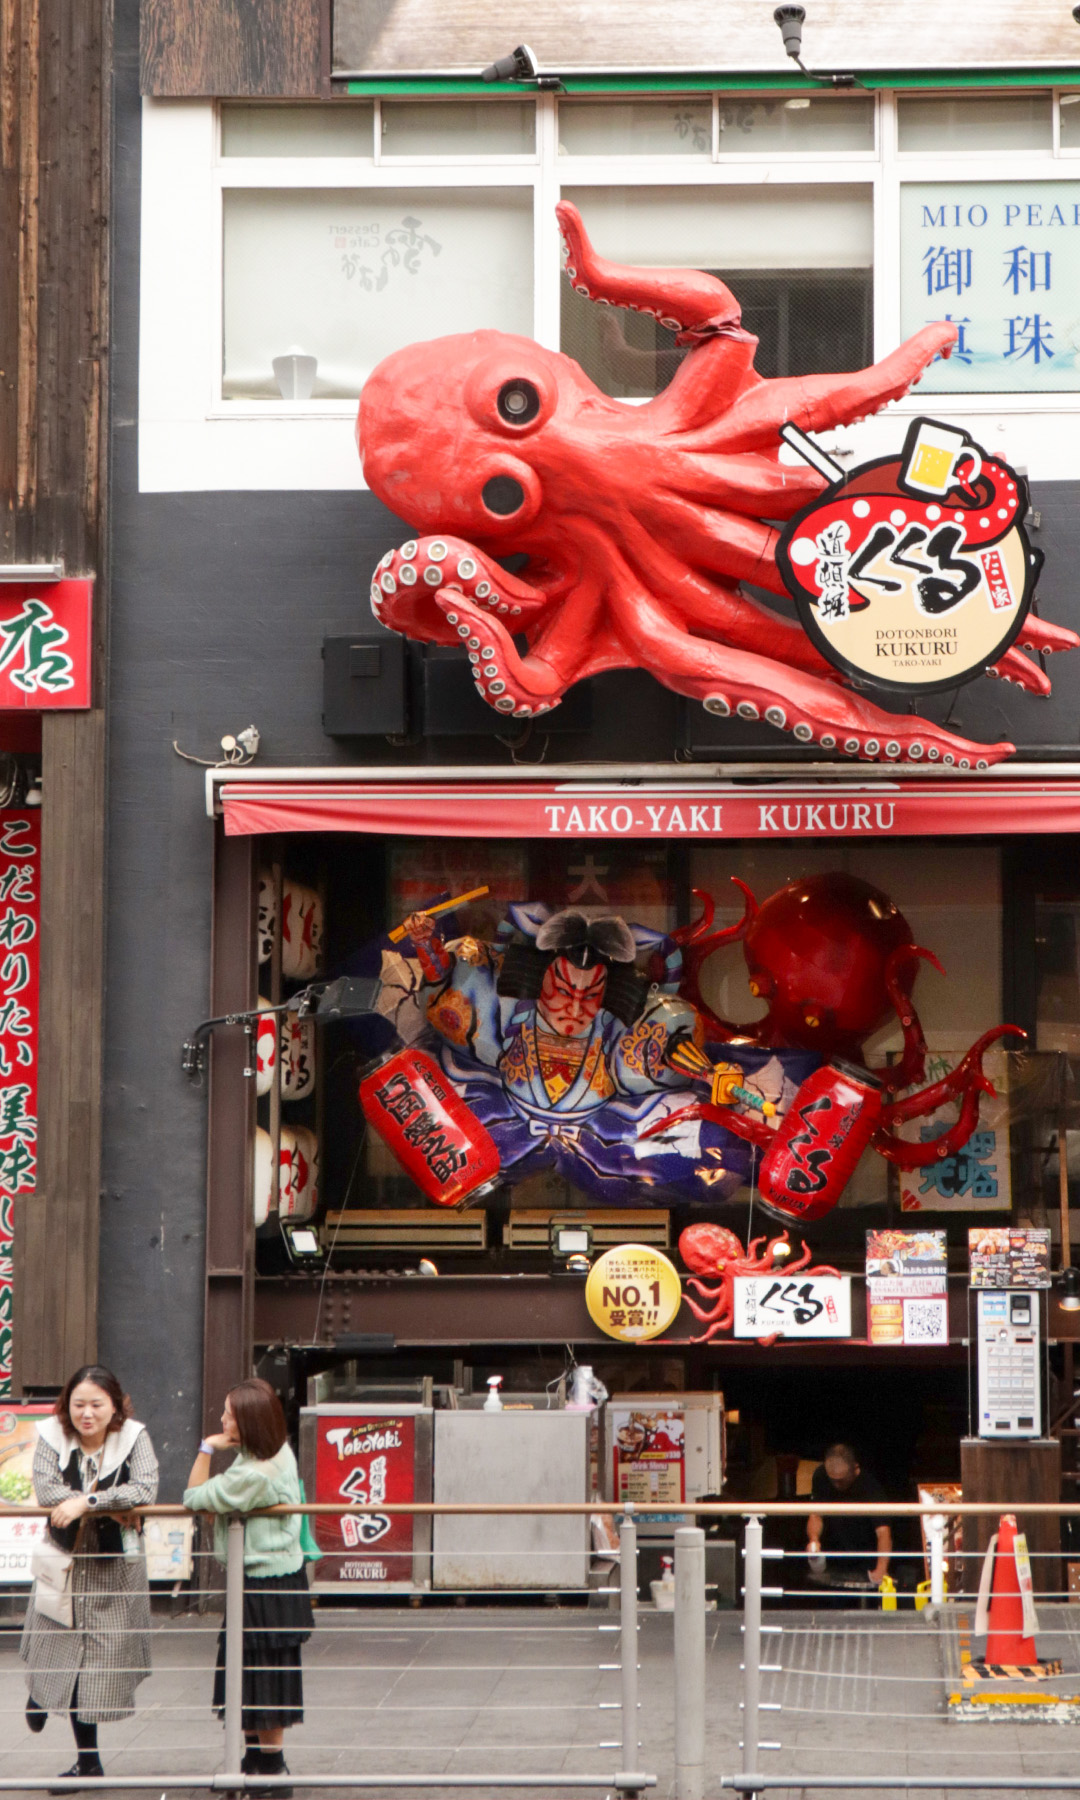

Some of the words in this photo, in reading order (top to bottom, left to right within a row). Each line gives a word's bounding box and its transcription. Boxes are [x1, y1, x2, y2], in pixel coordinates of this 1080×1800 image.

[921, 204, 988, 228] MIO
[819, 525, 849, 619] 道頓堀
[848, 526, 982, 614] くくる
[980, 549, 1013, 610] たこ家
[875, 628, 958, 640] DOTONBORI
[875, 641, 959, 657] KUKURU
[892, 659, 942, 667] TAKO-YAKI
[544, 804, 724, 832] TAKO-YAKI
[757, 802, 896, 831] KUKURU
[602, 1280, 660, 1307] NO.1
[760, 1282, 824, 1325] くくる
[631, 1461, 648, 1471] Drink
[649, 1461, 668, 1471] Menu
[339, 1567, 388, 1579] KUKURU
